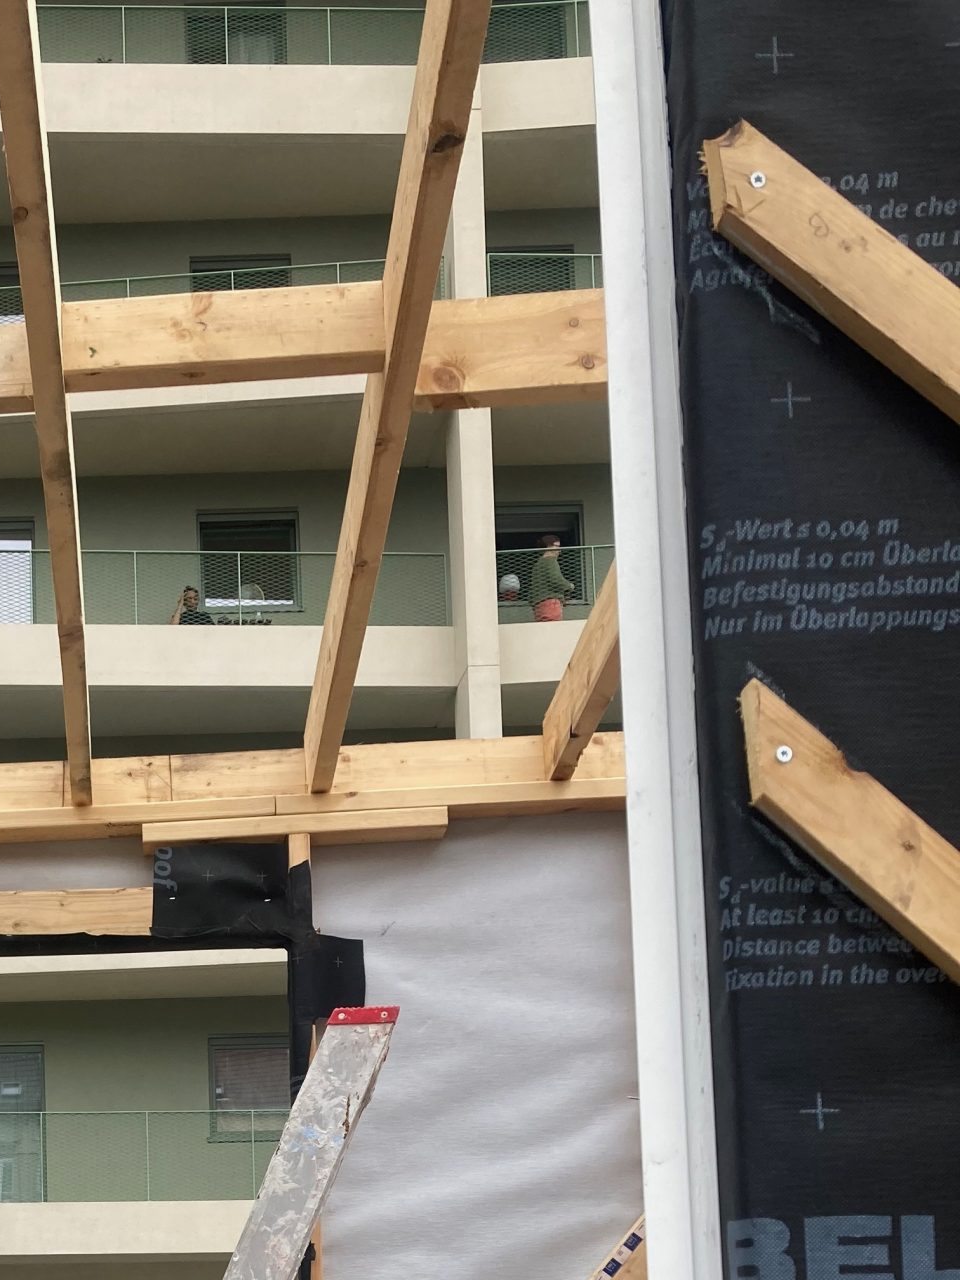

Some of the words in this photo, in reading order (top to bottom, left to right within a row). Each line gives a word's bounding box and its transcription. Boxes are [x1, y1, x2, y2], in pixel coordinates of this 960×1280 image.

[878, 171, 899, 188] m
[880, 198, 908, 219] de
[916, 196, 960, 219] che
[915, 231, 946, 248] au
[816, 520, 869, 541] 0,04
[877, 518, 899, 536] m
[702, 547, 801, 580] Minimal
[806, 551, 834, 568] 10
[840, 549, 875, 568] cm
[704, 615, 748, 641] Nur
[752, 610, 783, 633] im
[720, 905, 741, 932] At
[746, 903, 808, 926] least
[811, 907, 840, 924] 10
[722, 937, 822, 962] Distance
[724, 964, 814, 993] Fixation
[820, 963, 843, 986] in
[850, 962, 890, 985] the
